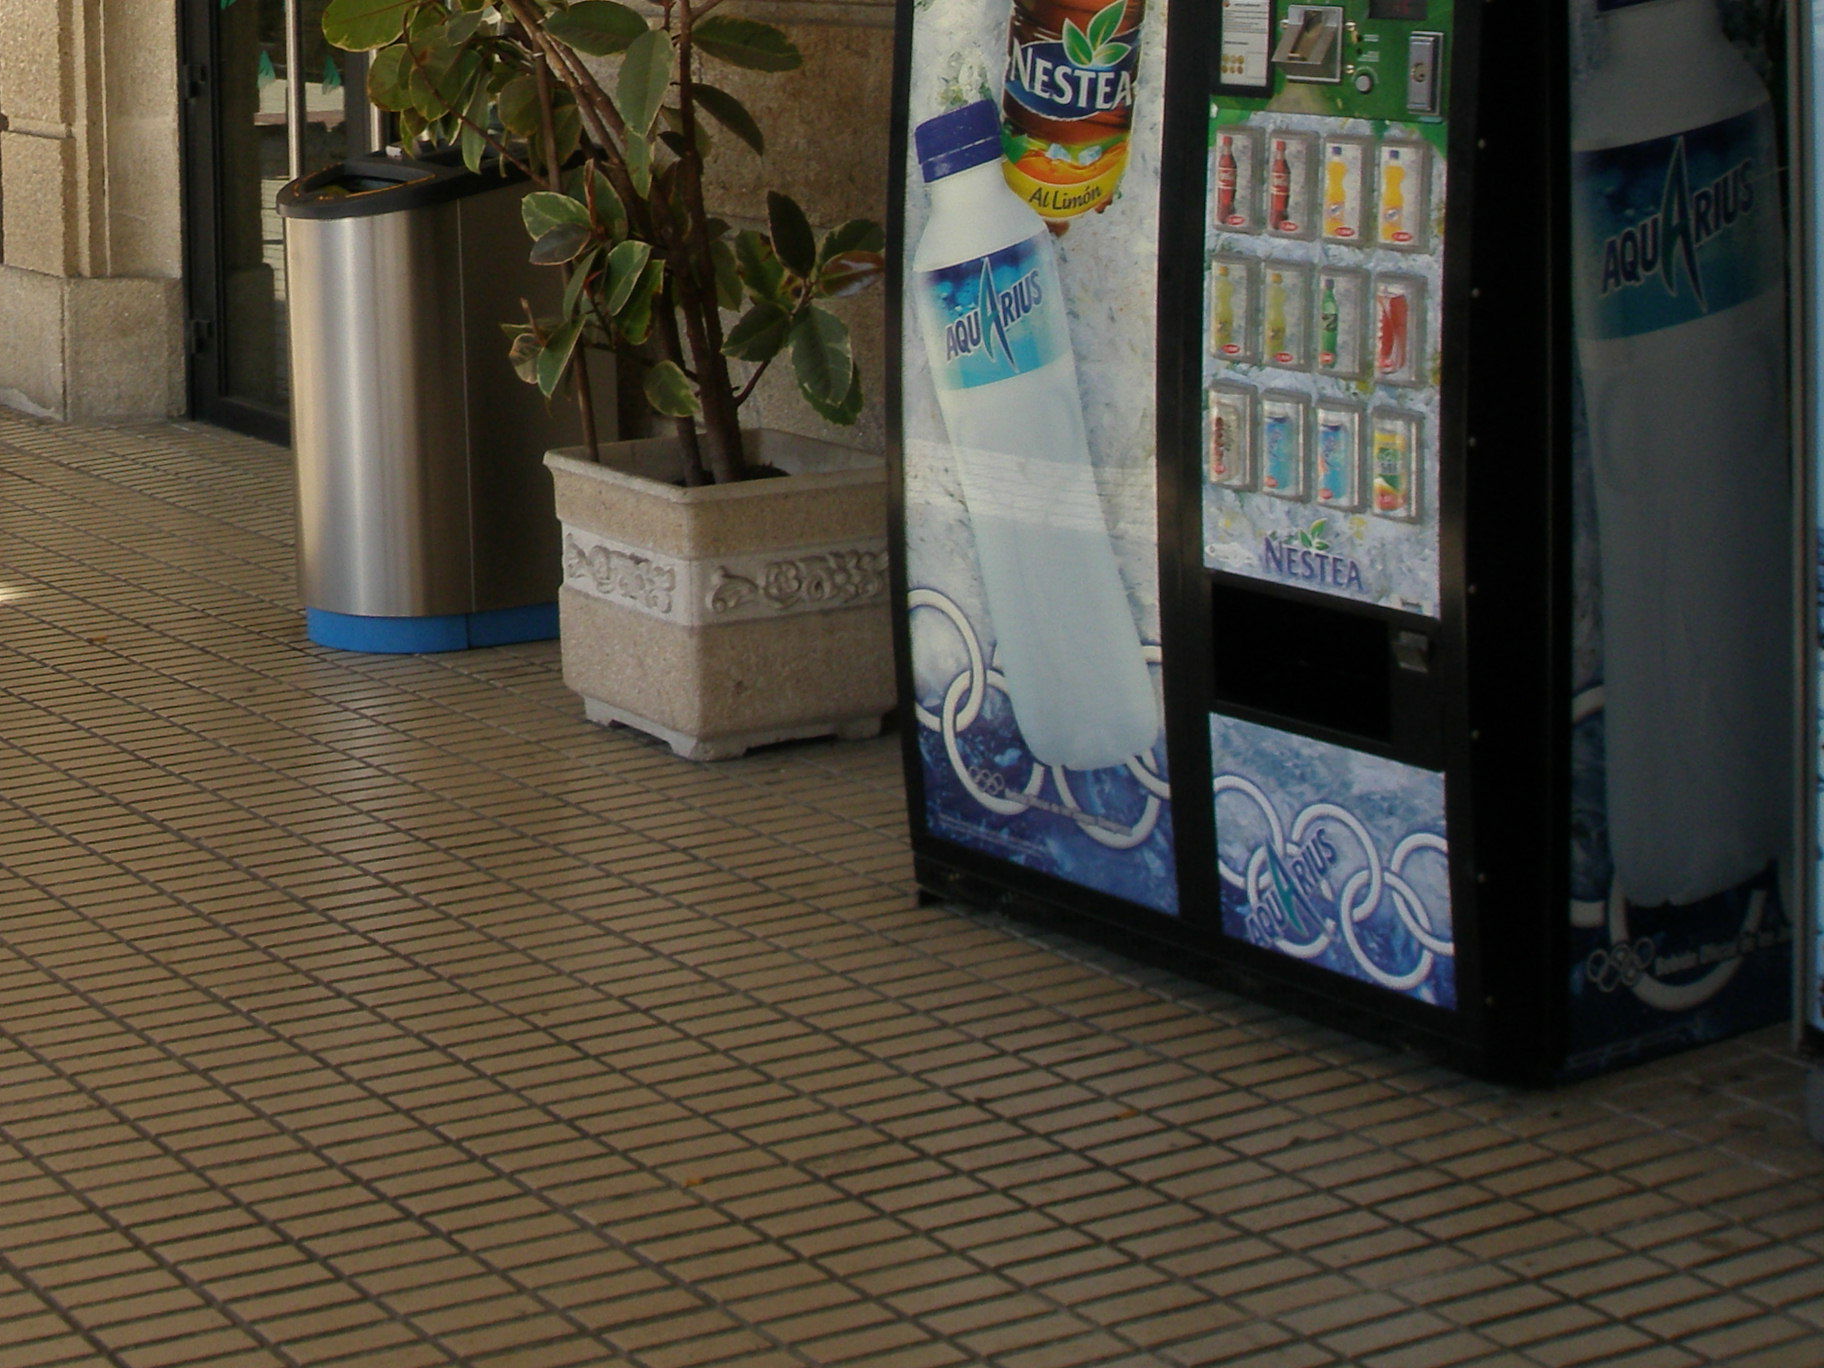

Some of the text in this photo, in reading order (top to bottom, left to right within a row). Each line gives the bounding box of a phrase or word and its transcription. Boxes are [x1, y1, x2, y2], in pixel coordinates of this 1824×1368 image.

[1008, 37, 1133, 111] NESTEA
[1029, 184, 1103, 211] Al Limón
[1599, 134, 1754, 315] AQUARIUS
[945, 256, 1043, 375] AQUARIUS
[1262, 535, 1370, 595] NESTEA
[1244, 827, 1338, 946] AQUARIUS
